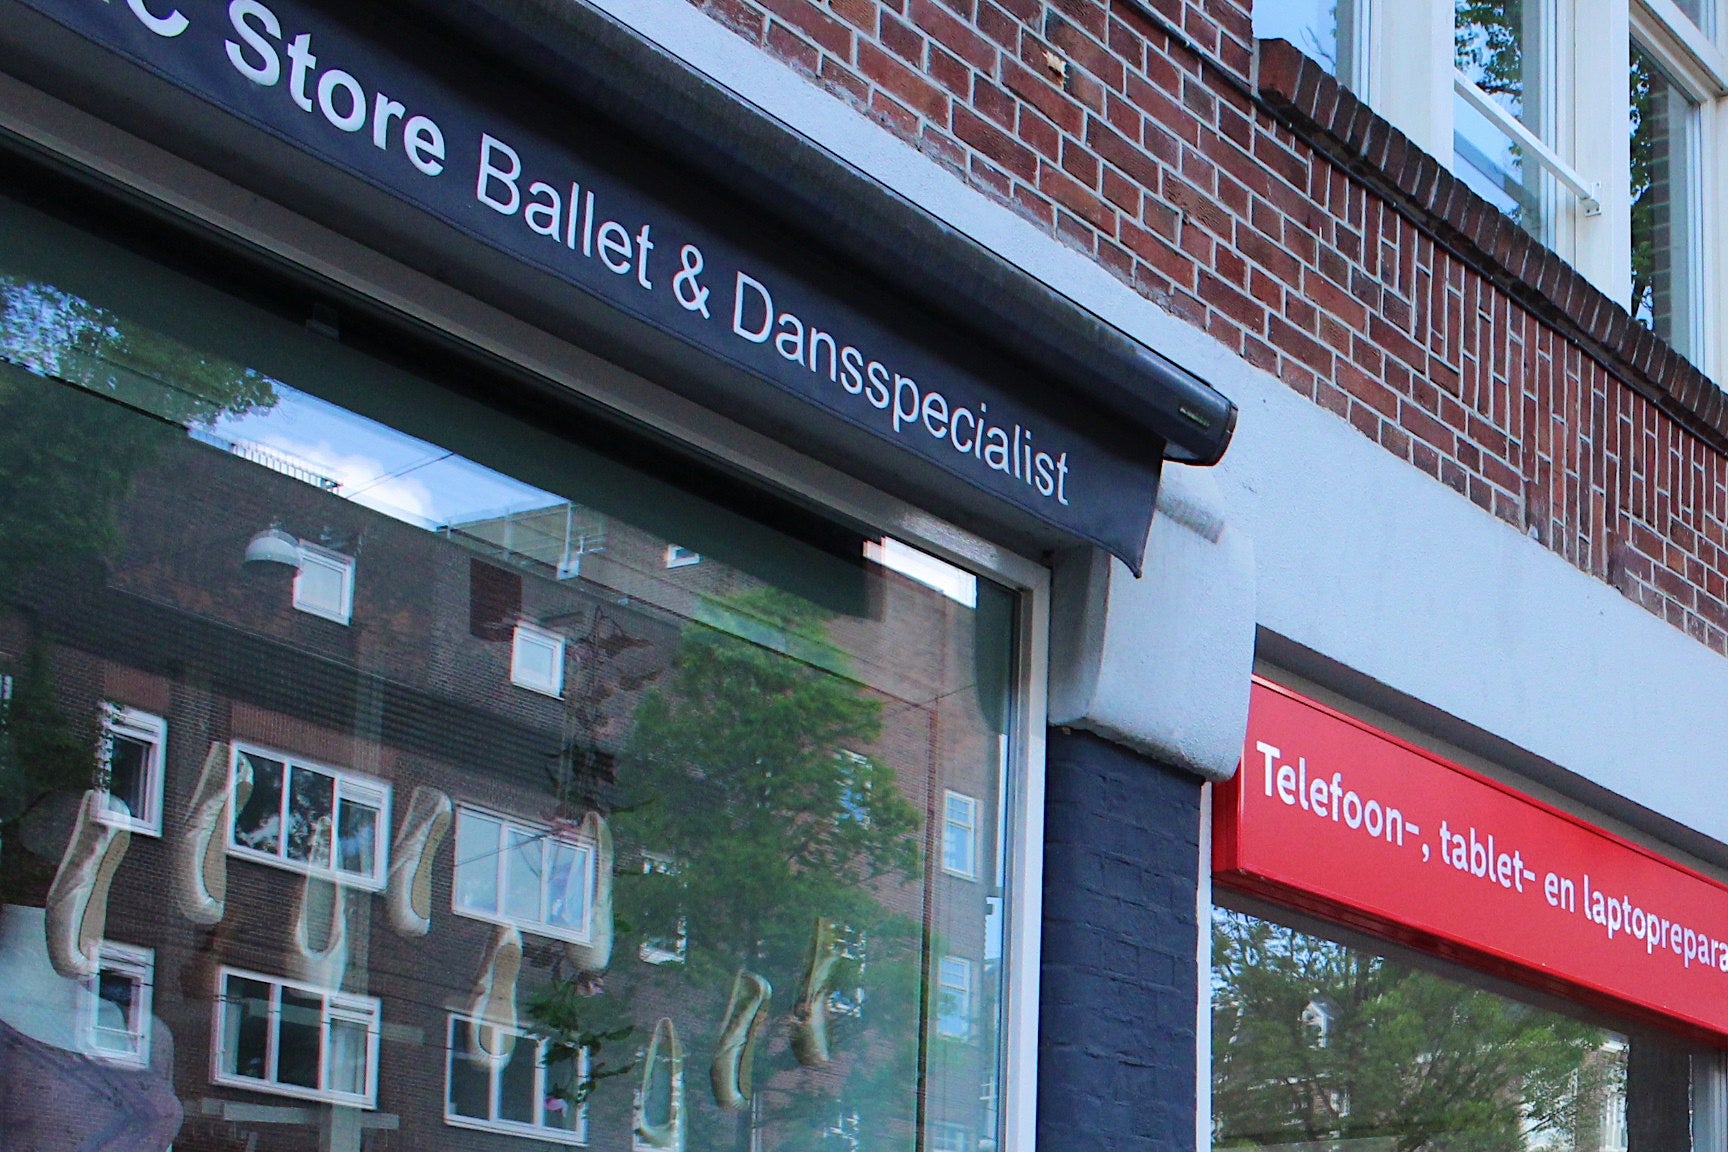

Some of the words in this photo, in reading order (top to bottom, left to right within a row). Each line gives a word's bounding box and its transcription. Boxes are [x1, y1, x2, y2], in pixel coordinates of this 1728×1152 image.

[224, 0, 446, 176] Store
[476, 132, 655, 291] Ballet
[672, 244, 711, 319] &
[733, 271, 1069, 506] Dansspecialist
[1439, 819, 1537, 893] tablet-
[1544, 872, 1575, 914] en
